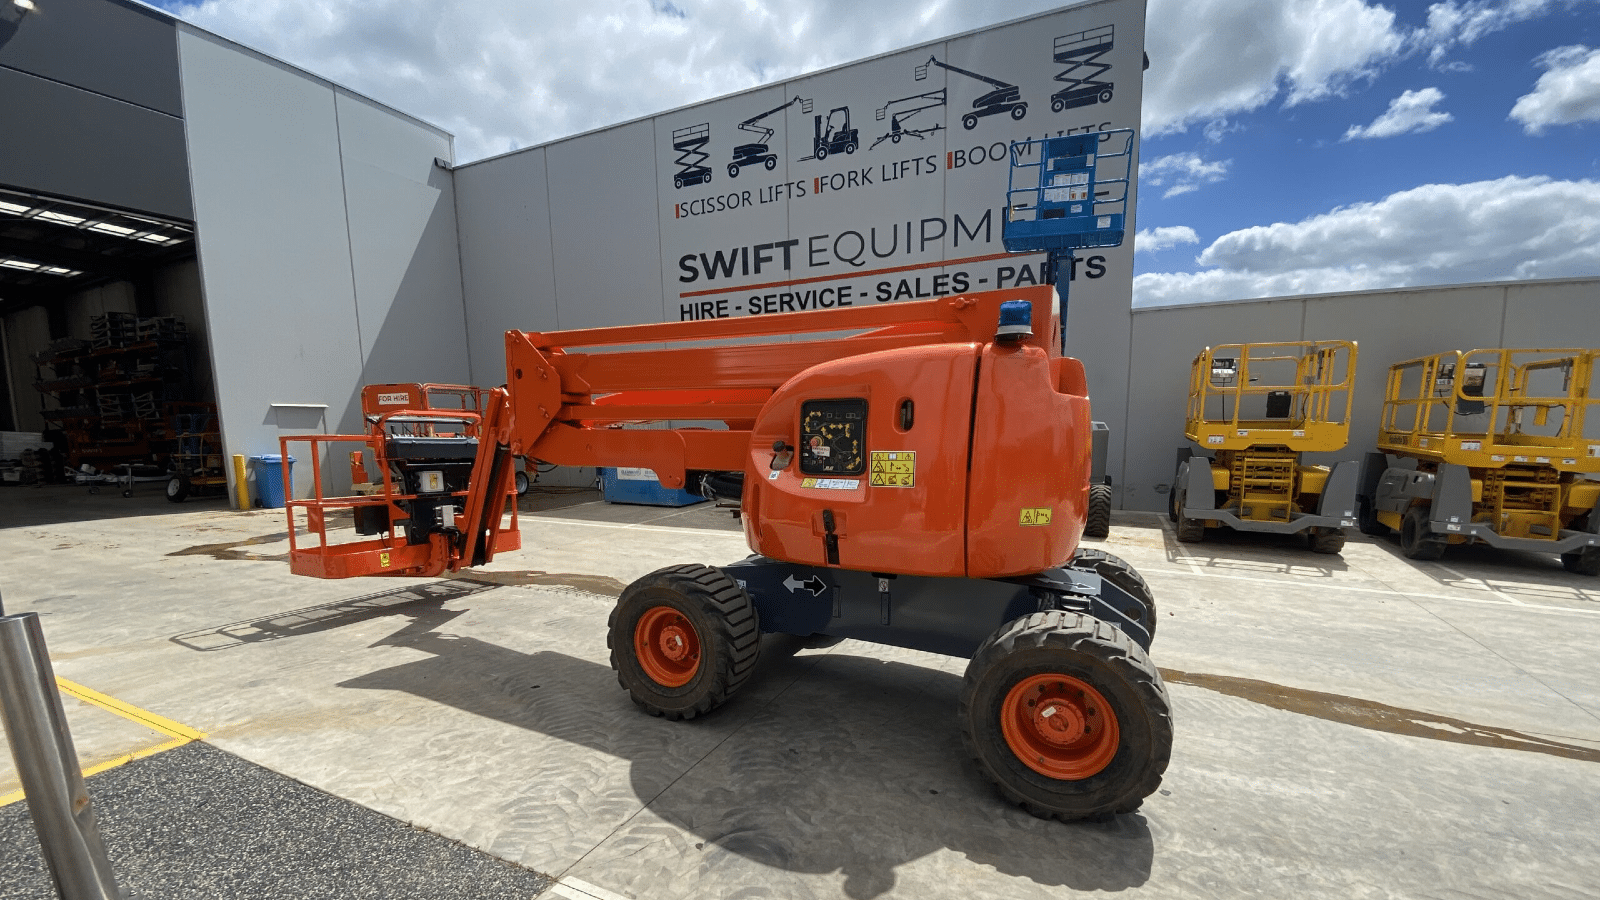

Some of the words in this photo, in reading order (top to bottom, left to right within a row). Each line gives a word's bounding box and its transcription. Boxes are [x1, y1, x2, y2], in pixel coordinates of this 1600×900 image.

[680, 190, 752, 218] SCISSOR
[759, 180, 806, 204] LIFTS
[820, 166, 873, 194] FORK
[882, 155, 937, 182] LIFTS
[954, 136, 1032, 168] BOOM
[679, 239, 799, 283] SWIFT
[809, 191, 1109, 267] EQUIPM
[680, 299, 729, 321] HIRE
[748, 286, 852, 315] SERVICE
[876, 272, 969, 302] SALES
[393, 394, 408, 402] HIRE
